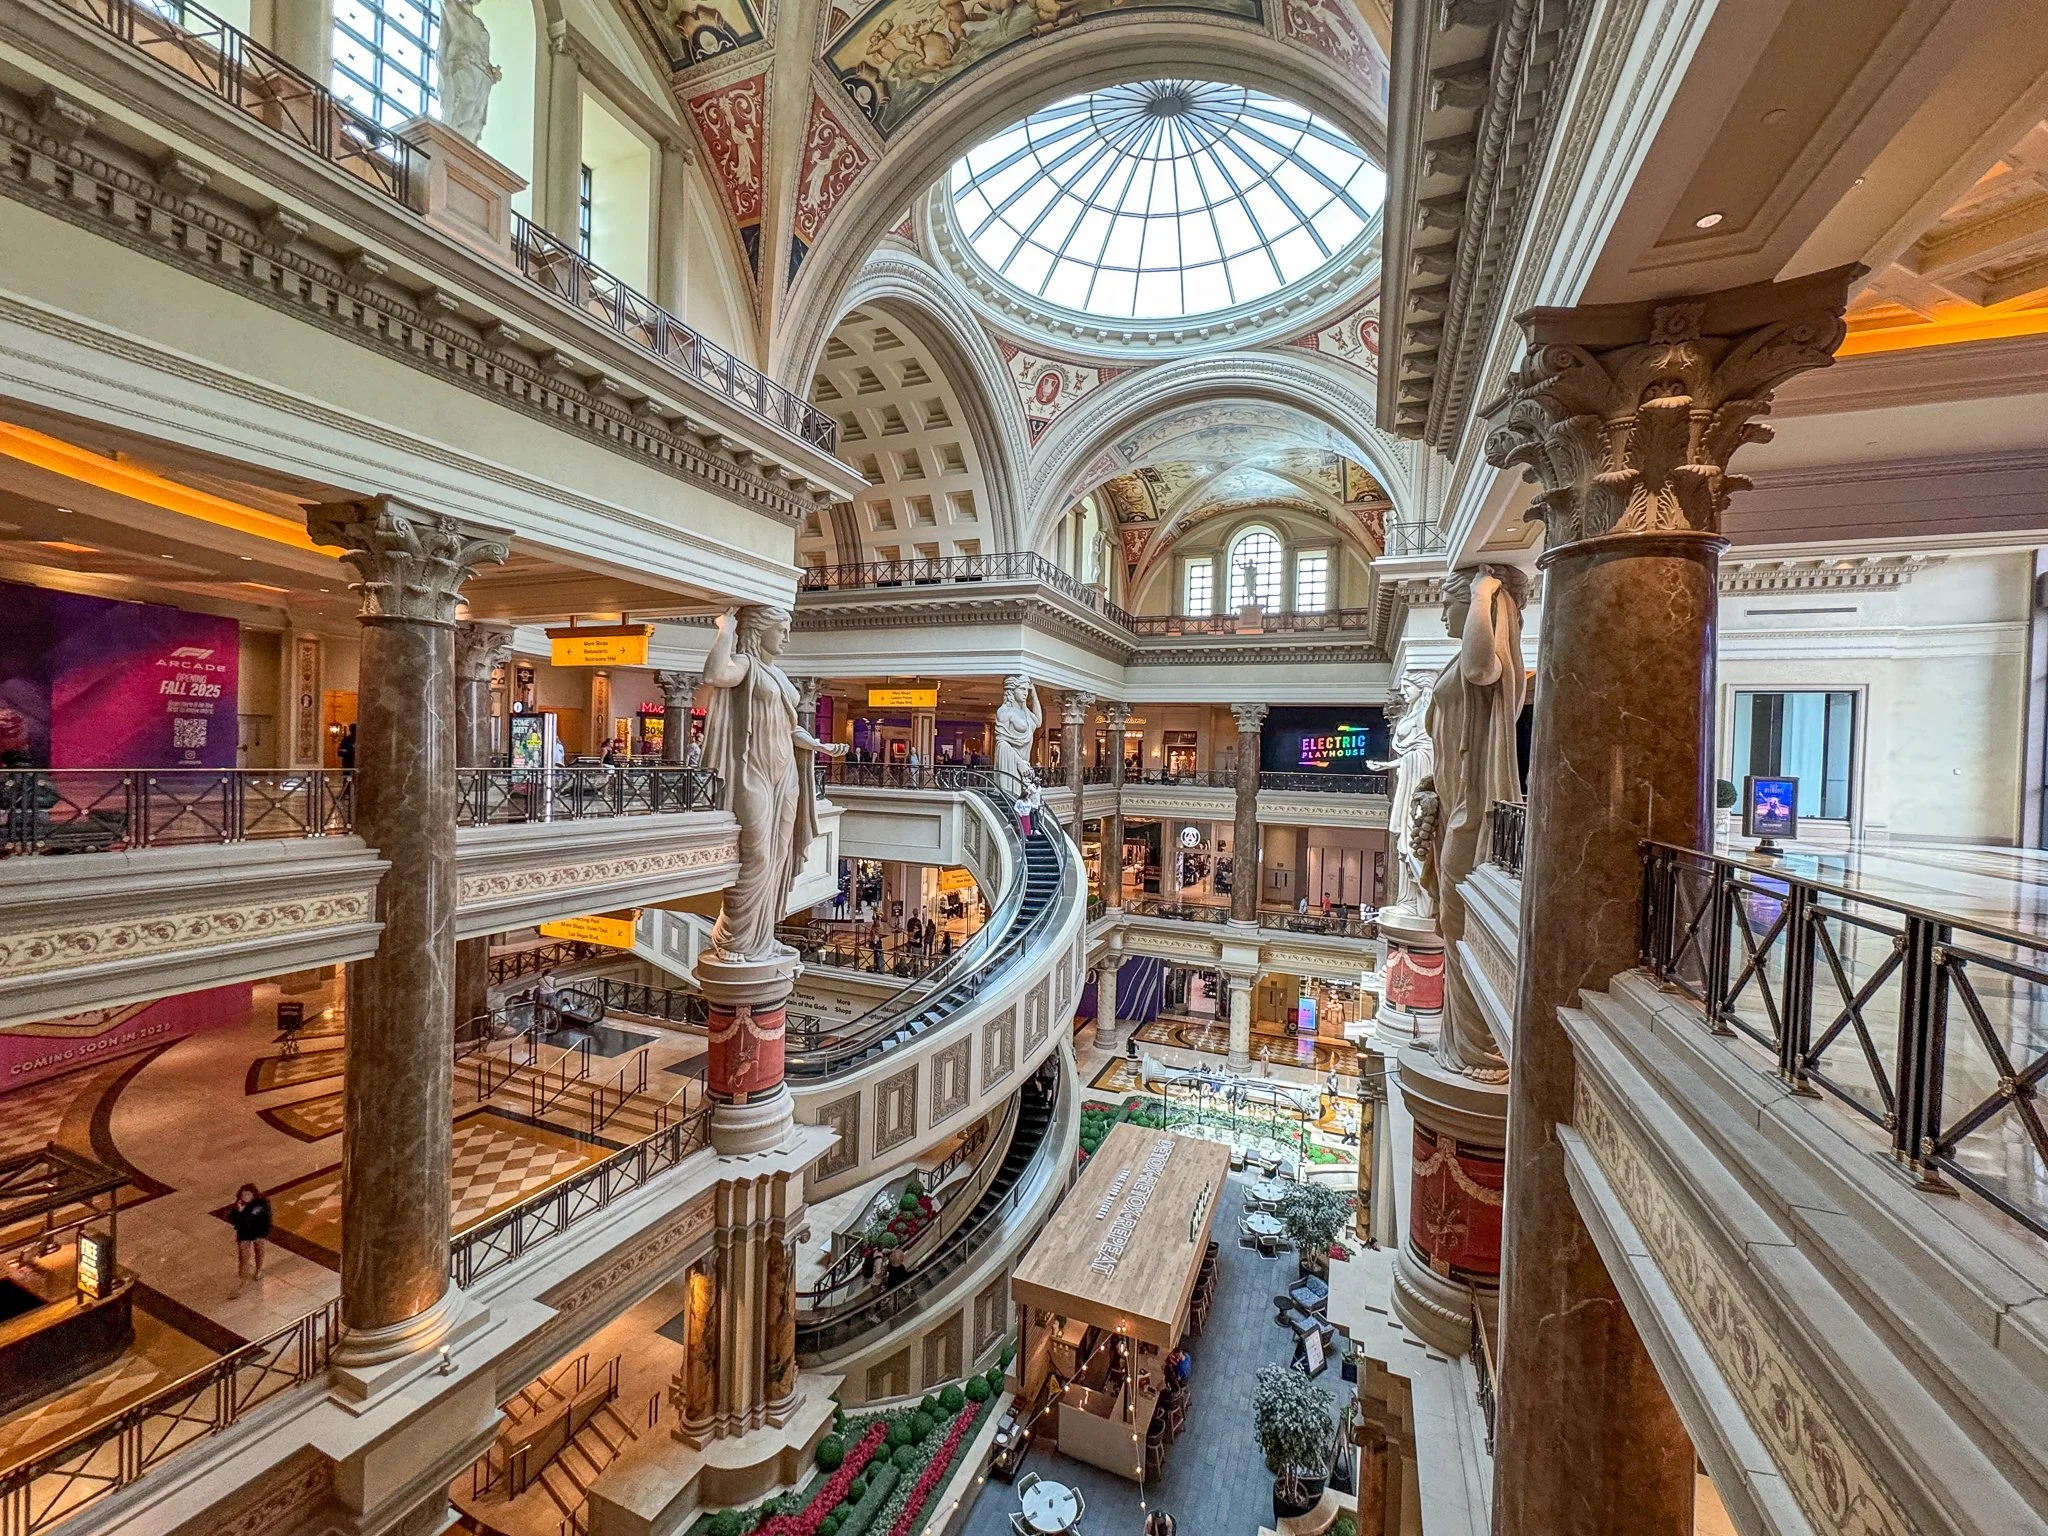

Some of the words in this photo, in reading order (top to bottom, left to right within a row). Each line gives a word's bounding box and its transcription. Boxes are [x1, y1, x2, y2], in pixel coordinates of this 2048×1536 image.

[156, 659, 226, 672] ARCADE
[176, 673, 208, 684] OPENING
[160, 680, 187, 695] FALL
[189, 683, 222, 698] 2025
[1302, 735, 1366, 751] ELECTRIC
[1302, 748, 1365, 759] PLAYHOUSE
[796, 991, 815, 1001] Terrace
[813, 1003, 828, 1011] Gods
[836, 998, 851, 1006] More
[834, 1006, 852, 1015] Shops
[10, 1050, 75, 1076] COMING
[78, 1037, 119, 1056] SOON
[122, 1031, 136, 1044] IN
